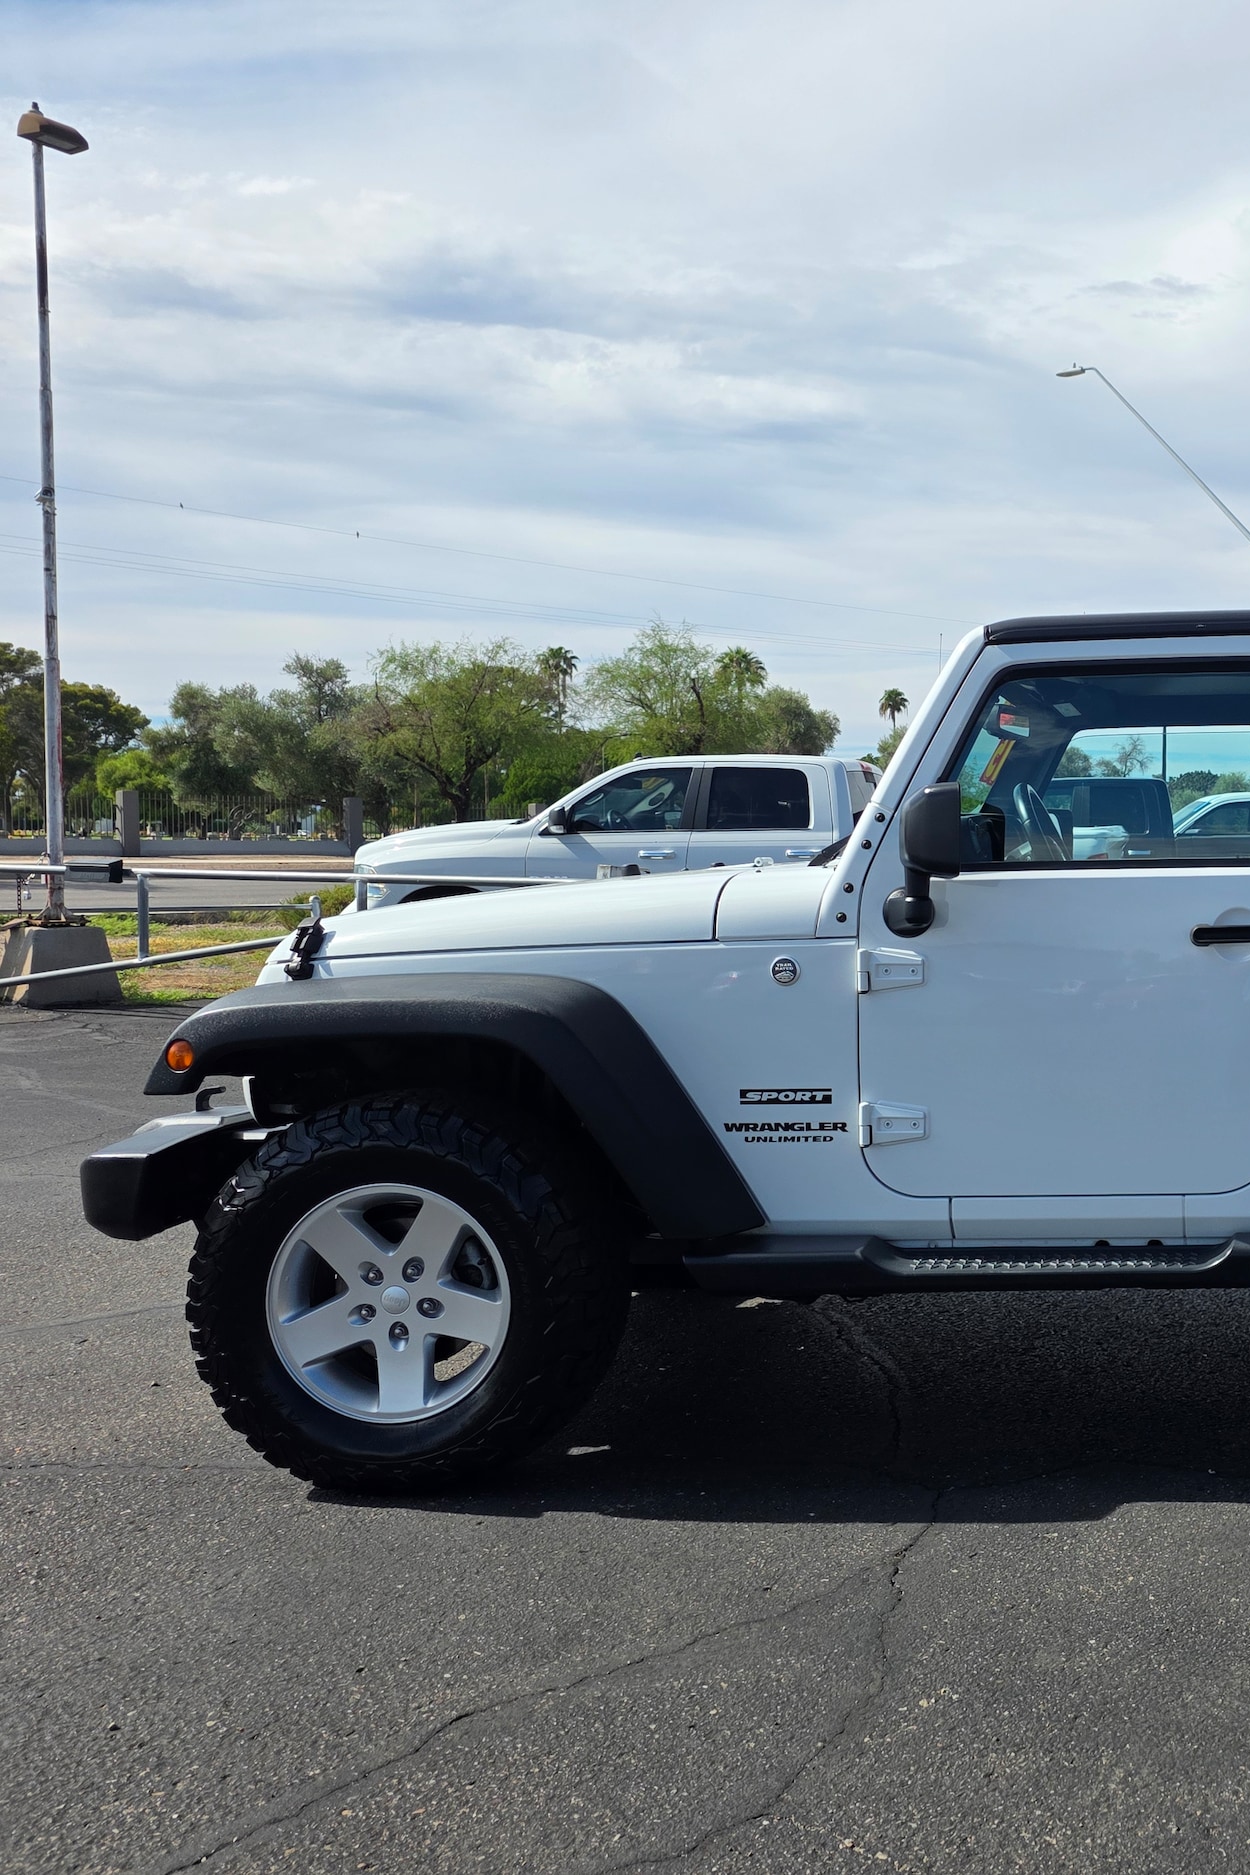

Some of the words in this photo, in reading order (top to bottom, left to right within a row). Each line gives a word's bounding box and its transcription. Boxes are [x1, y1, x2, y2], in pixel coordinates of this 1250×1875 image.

[742, 1090, 832, 1102] SPORT
[723, 1122, 848, 1133] WRANGLER
[744, 1135, 834, 1143] UNLIMITED
